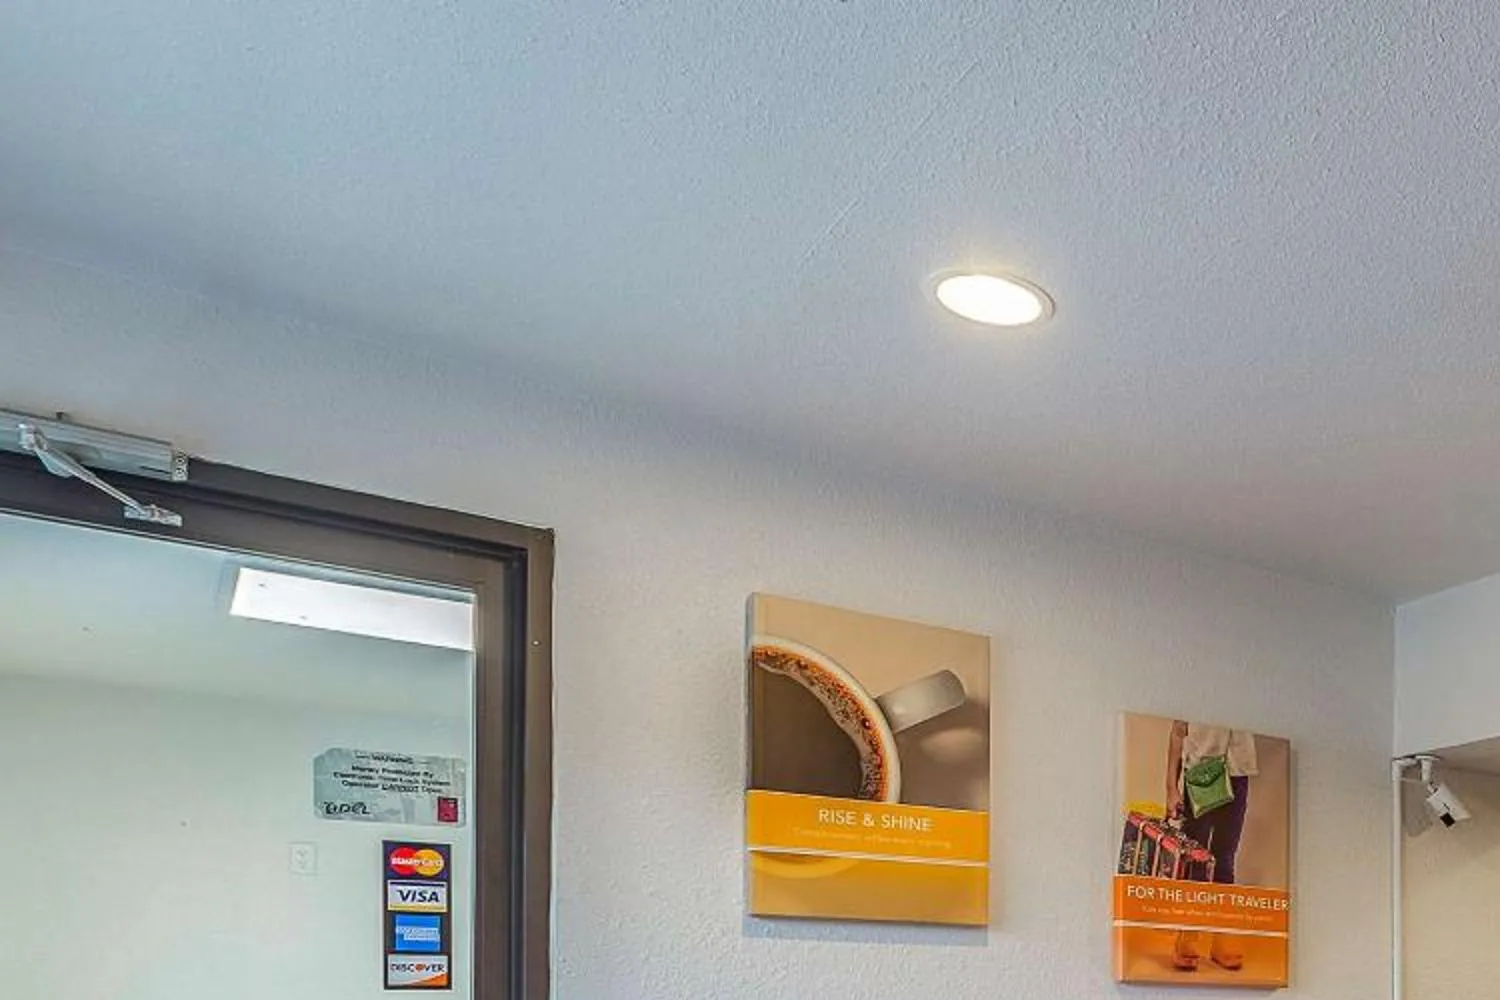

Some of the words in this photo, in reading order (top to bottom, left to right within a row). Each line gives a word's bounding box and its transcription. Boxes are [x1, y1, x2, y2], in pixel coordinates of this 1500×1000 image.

[818, 808, 857, 826] RISE
[863, 813, 875, 827] &
[881, 815, 934, 832] SHINE
[396, 889, 440, 903] VISA
[1127, 885, 1154, 899] FOR
[1159, 887, 1183, 903] THE
[1186, 891, 1226, 906] LIGHT
[390, 963, 446, 973] DISCOVER
